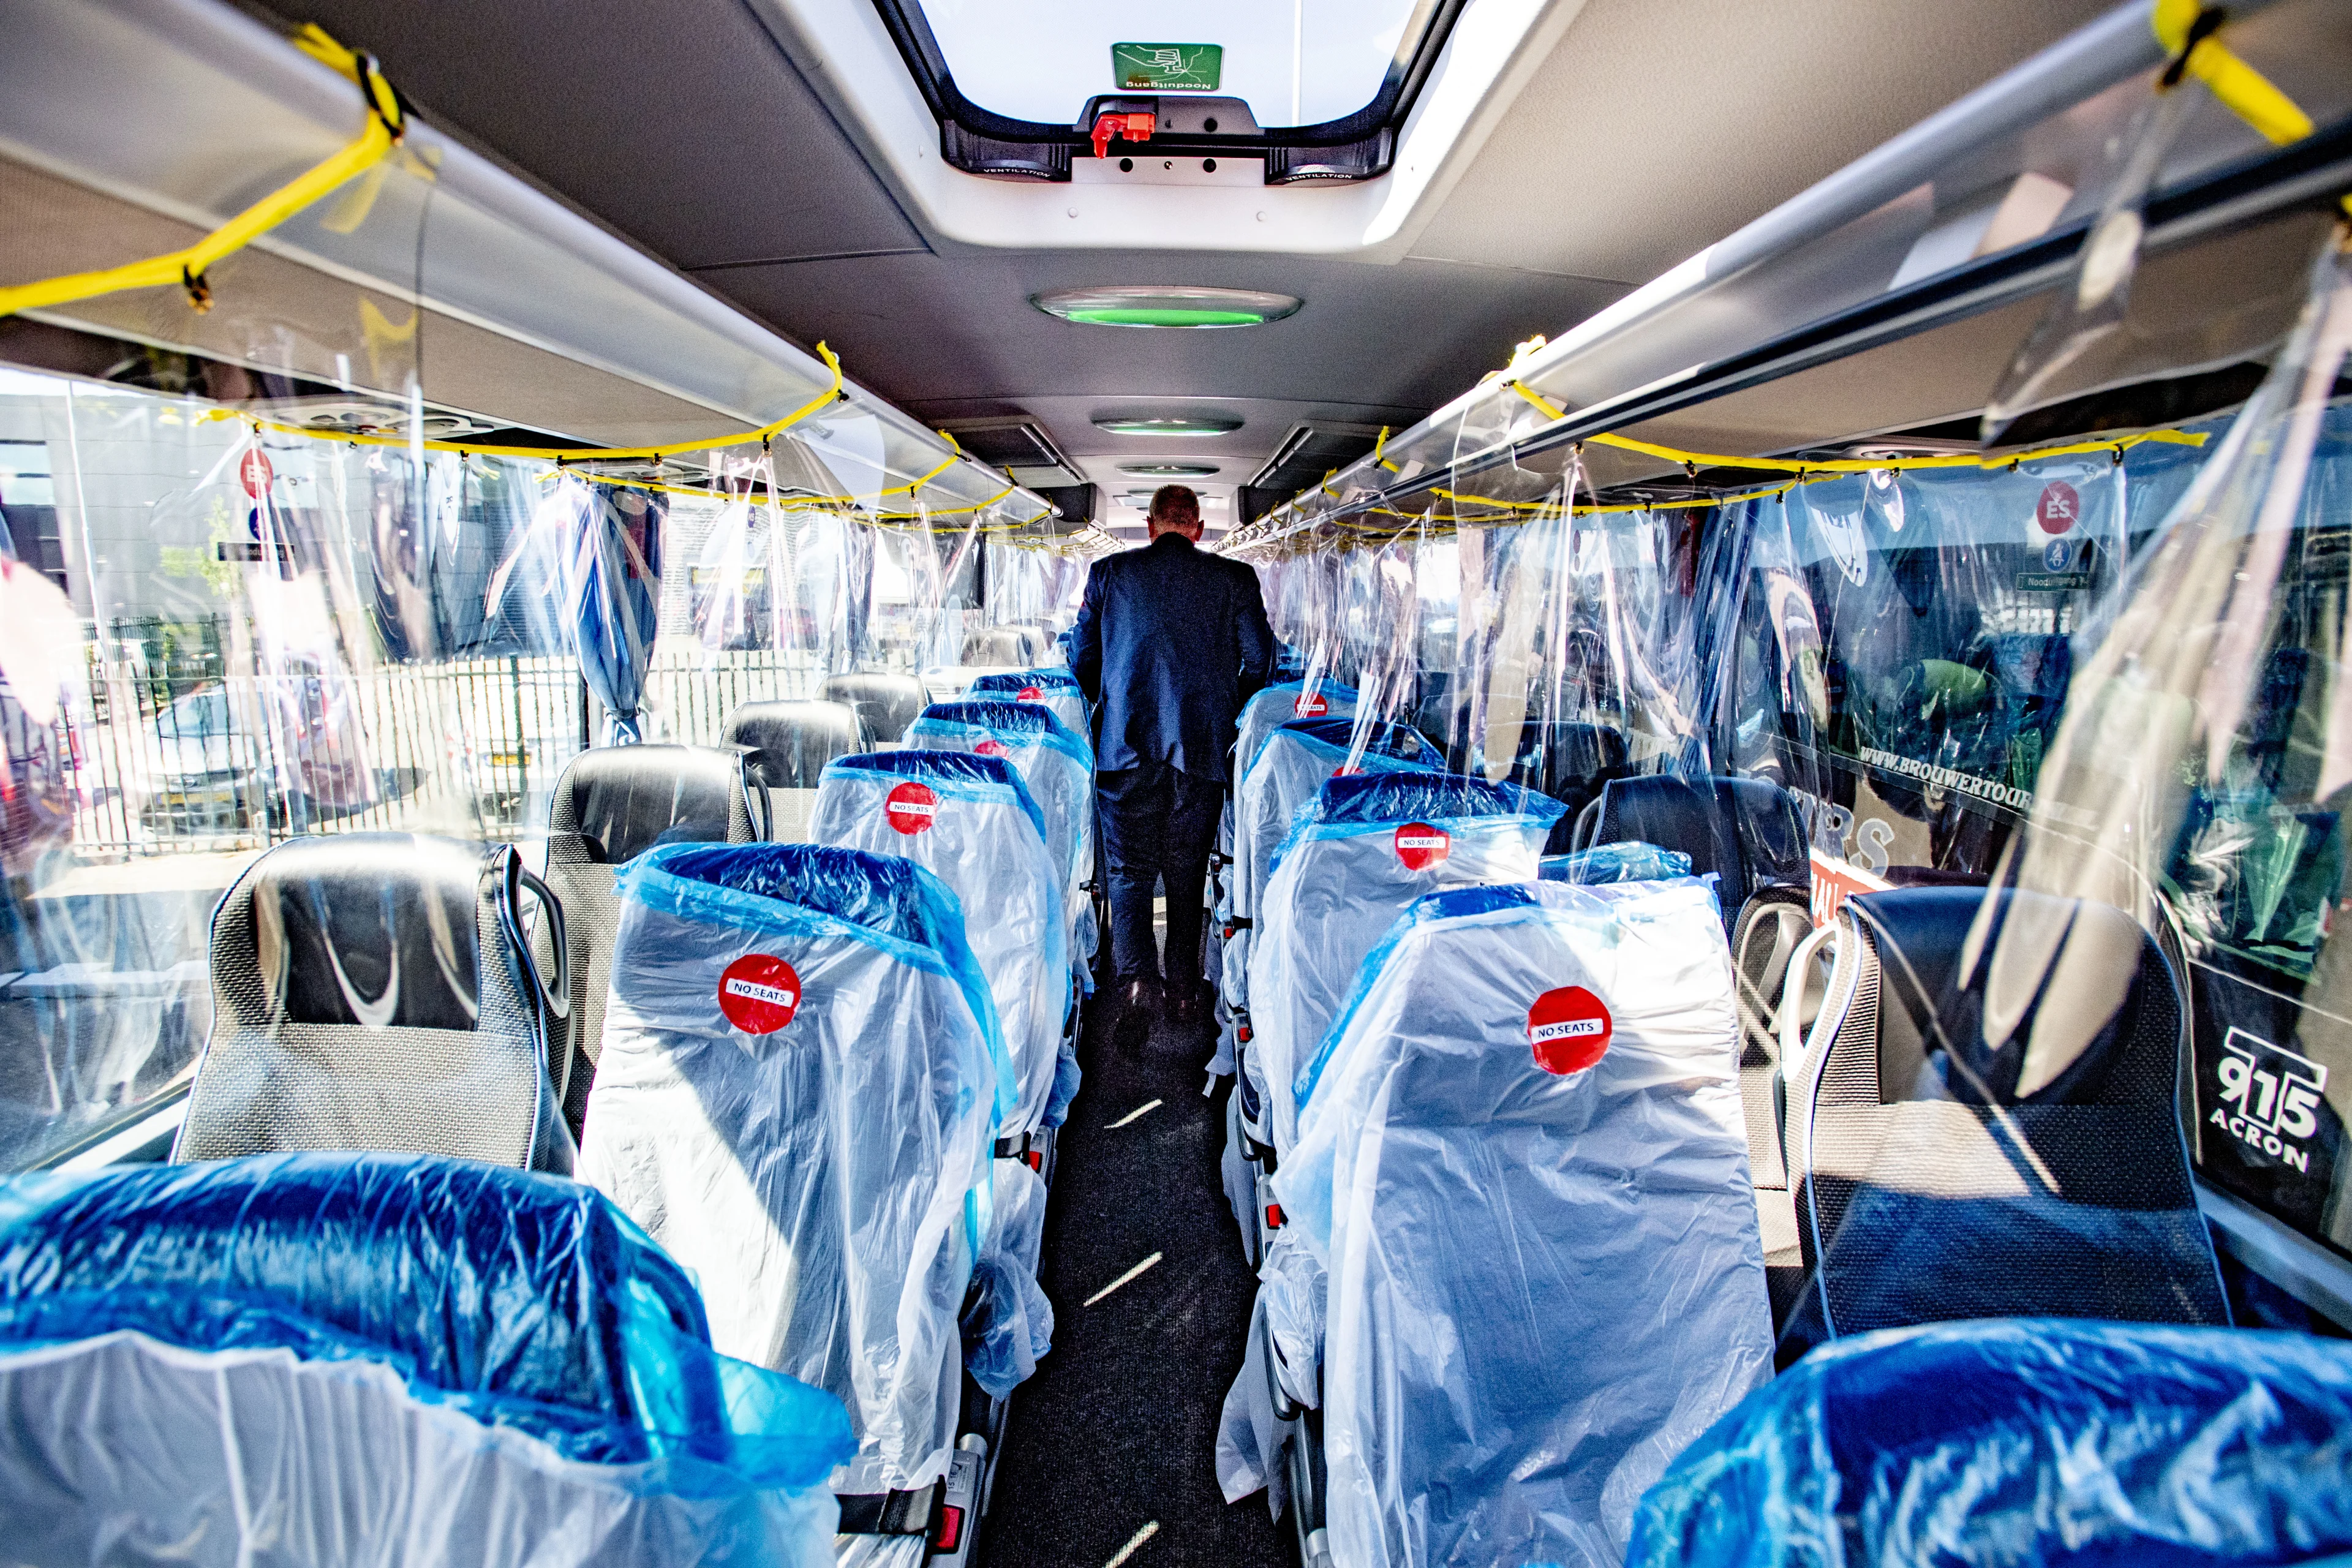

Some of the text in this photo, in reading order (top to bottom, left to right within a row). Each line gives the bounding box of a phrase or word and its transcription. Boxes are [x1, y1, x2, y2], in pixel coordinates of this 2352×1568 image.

[1126, 81, 1211, 89] Nooduitgang
[983, 168, 1050, 177] VENTILATION
[2046, 500, 2071, 519] ES
[734, 983, 786, 1002] NO SEATS
[1538, 1023, 1594, 1038] NO SEATS
[2209, 1108, 2310, 1173] ACRON
